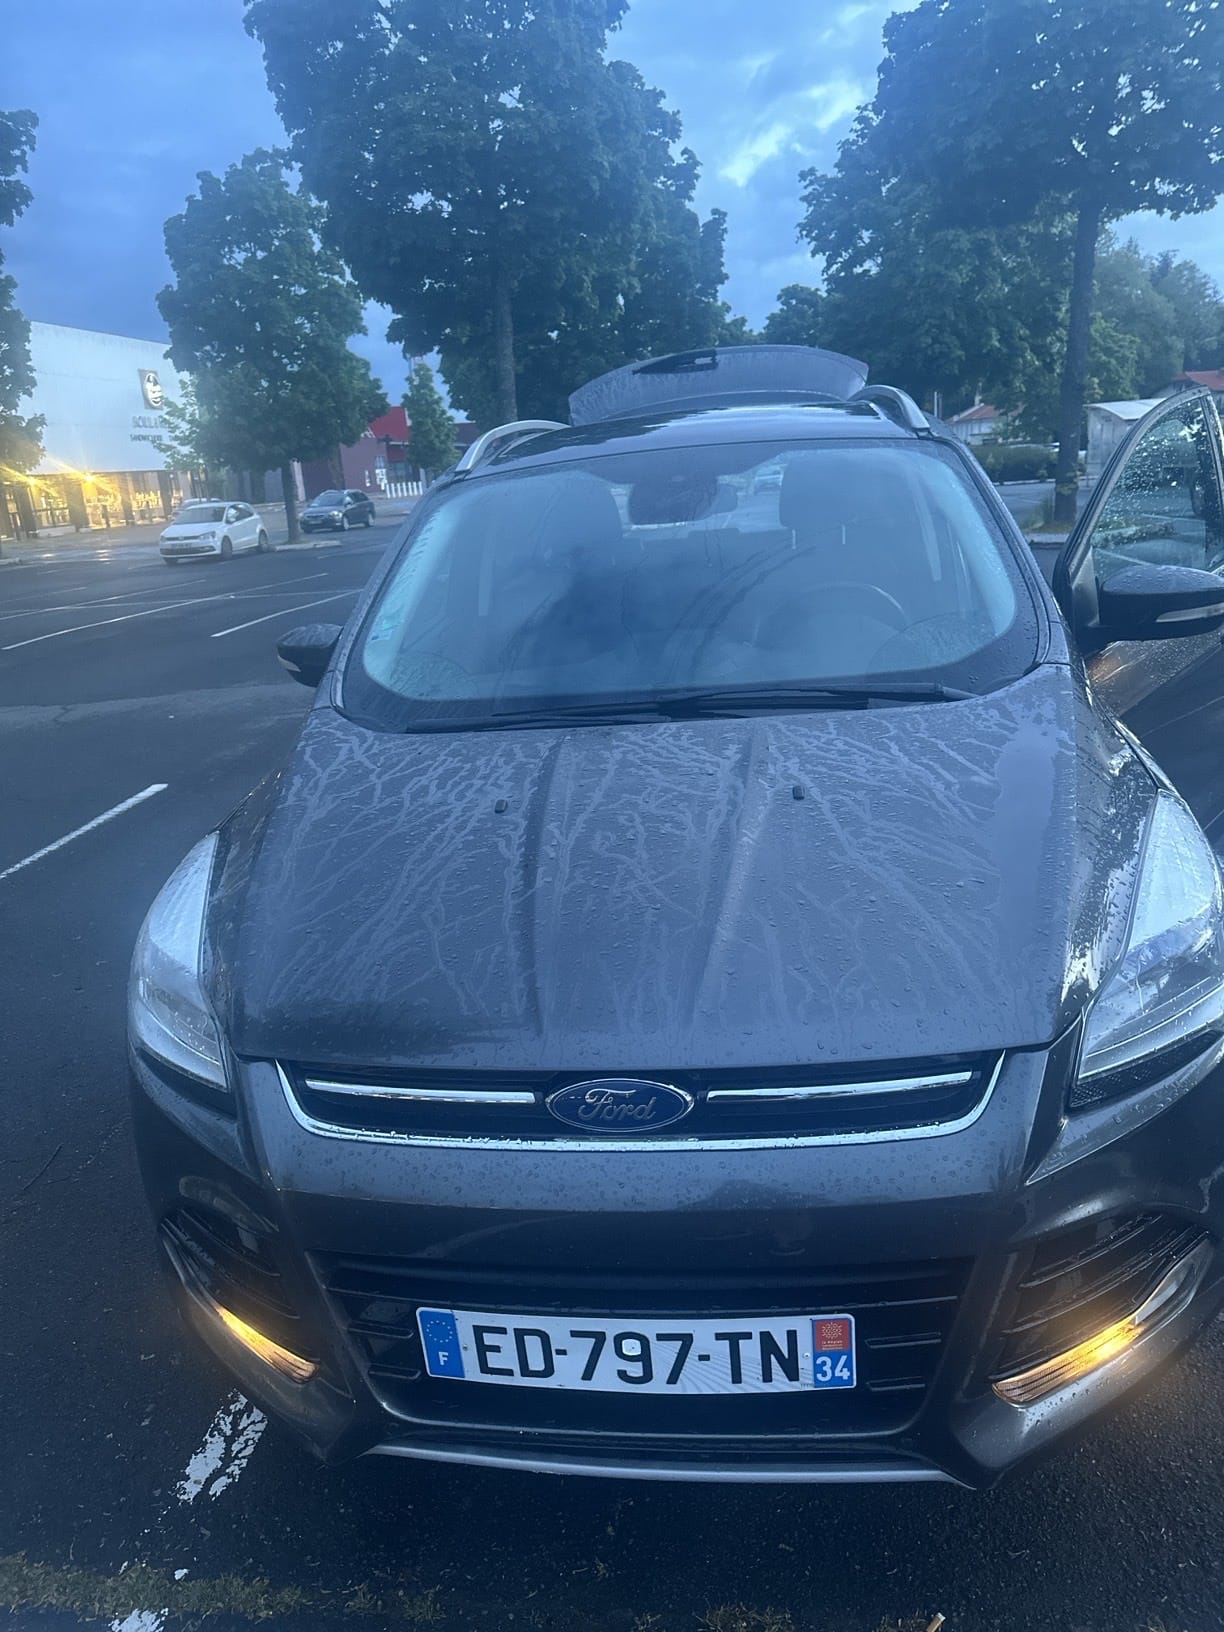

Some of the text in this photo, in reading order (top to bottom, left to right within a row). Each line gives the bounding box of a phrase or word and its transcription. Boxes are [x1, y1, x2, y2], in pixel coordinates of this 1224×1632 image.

[577, 1088, 657, 1121] Ford
[438, 1351, 449, 1366] F
[472, 1324, 800, 1384] ED-797-TN
[815, 1354, 851, 1382] 34
